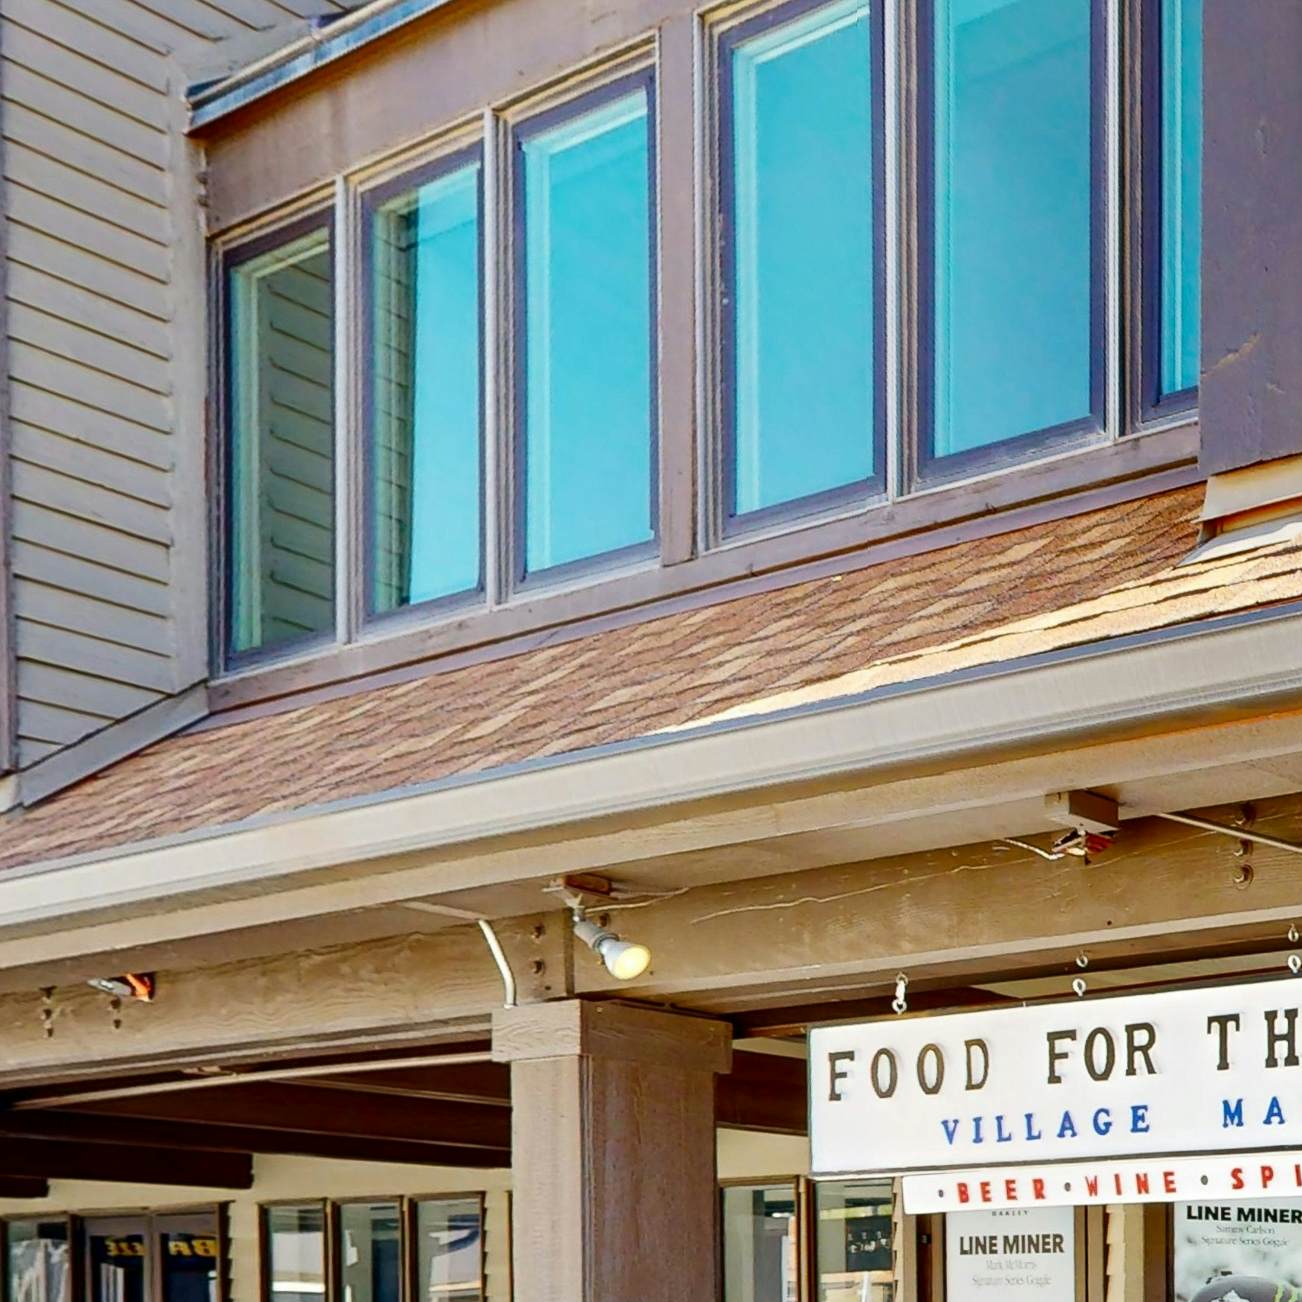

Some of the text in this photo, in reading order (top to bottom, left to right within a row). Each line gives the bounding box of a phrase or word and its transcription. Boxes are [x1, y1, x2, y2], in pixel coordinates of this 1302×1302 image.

[828, 1038, 990, 1102] FOOD
[1047, 1021, 1158, 1084] FOR
[941, 1104, 1151, 1145] VILLAGE
[956, 1177, 1047, 1203] BEER
[1084, 1170, 1178, 1196] WINE
[1186, 1205, 1231, 1221] LINE
[959, 1233, 1065, 1256] LINE MINER
